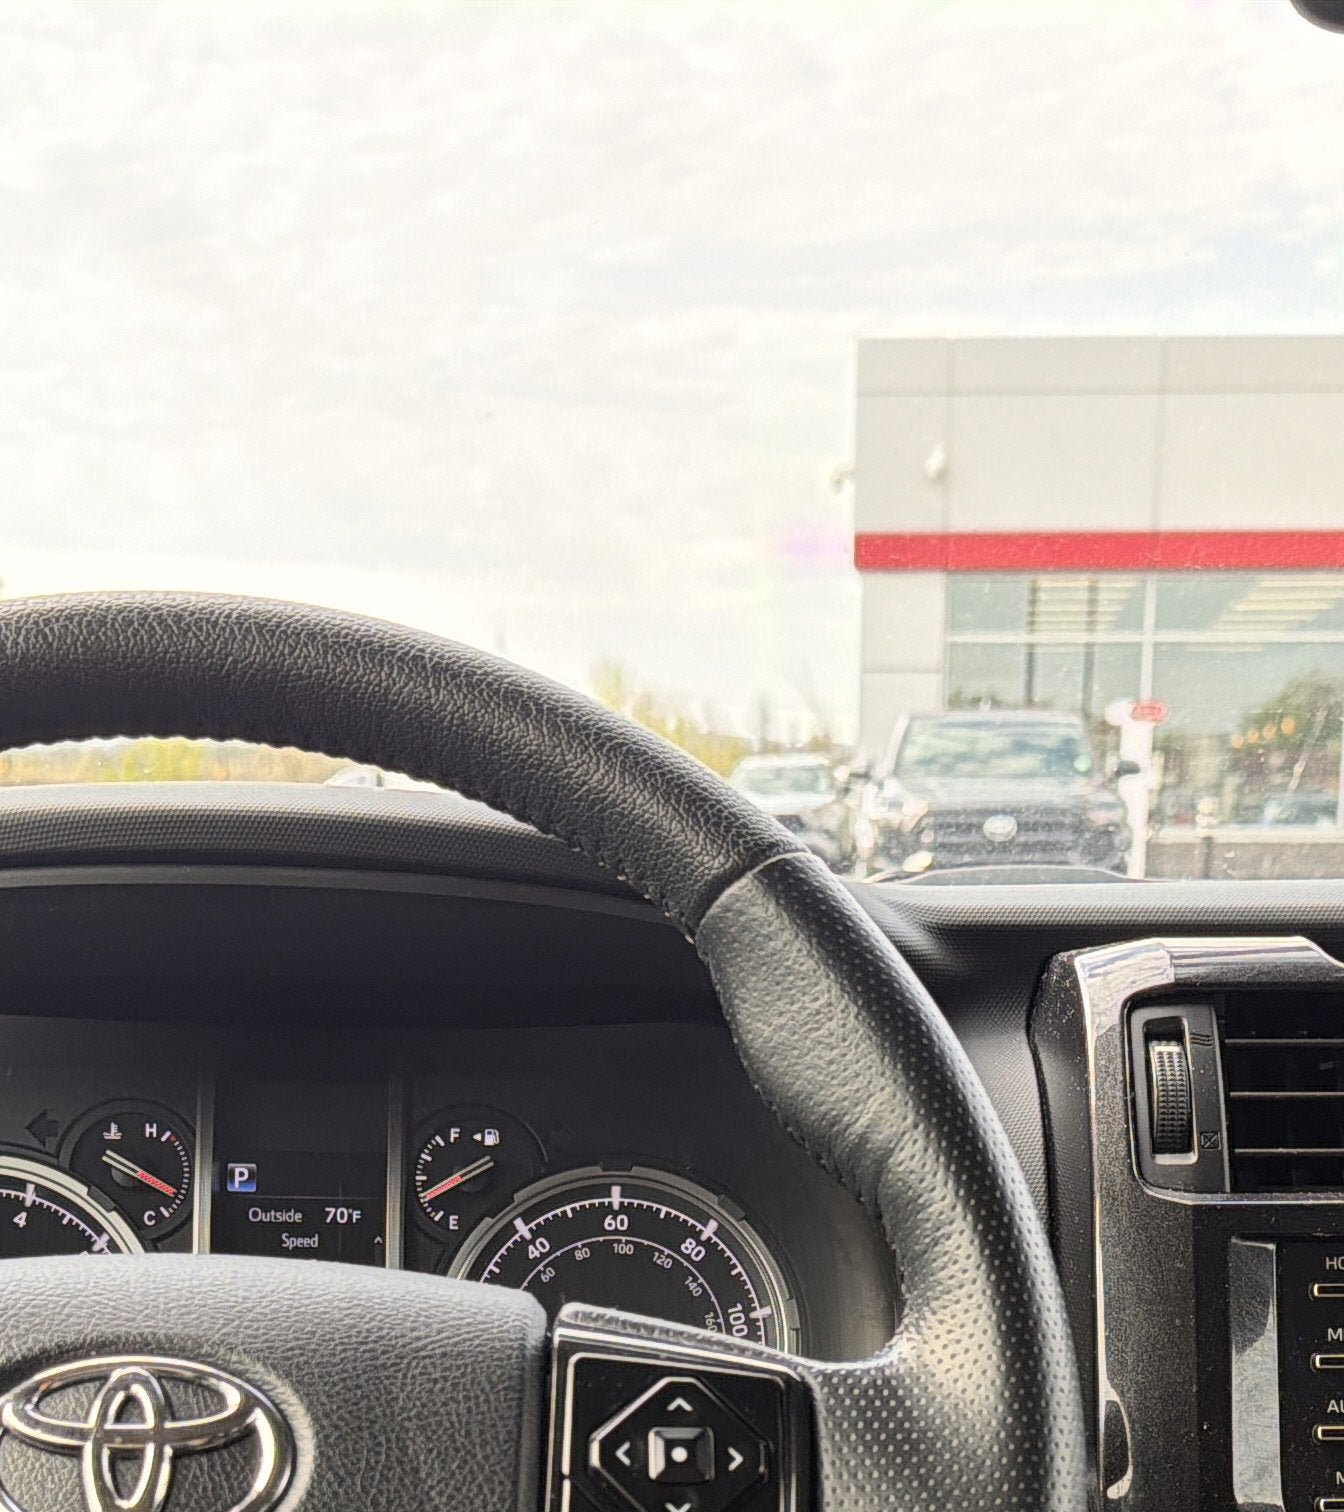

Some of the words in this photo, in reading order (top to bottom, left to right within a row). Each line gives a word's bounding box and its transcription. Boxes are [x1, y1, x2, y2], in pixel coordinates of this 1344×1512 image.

[145, 1123, 158, 1138] H
[449, 1127, 461, 1143] F
[234, 1167, 249, 1189] P
[12, 1211, 27, 1228] 4
[143, 1209, 157, 1226] C
[248, 1207, 303, 1223] Outside
[448, 1215, 459, 1230] E
[603, 1214, 629, 1231] 60
[281, 1232, 319, 1251] Speed
[526, 1237, 551, 1260] 40
[612, 1243, 635, 1256] 100
[680, 1237, 706, 1263] 80
[574, 1247, 591, 1262] 80
[652, 1252, 673, 1270] 120
[540, 1266, 557, 1283] 60
[684, 1275, 704, 1297] 140
[727, 1302, 749, 1338] 100
